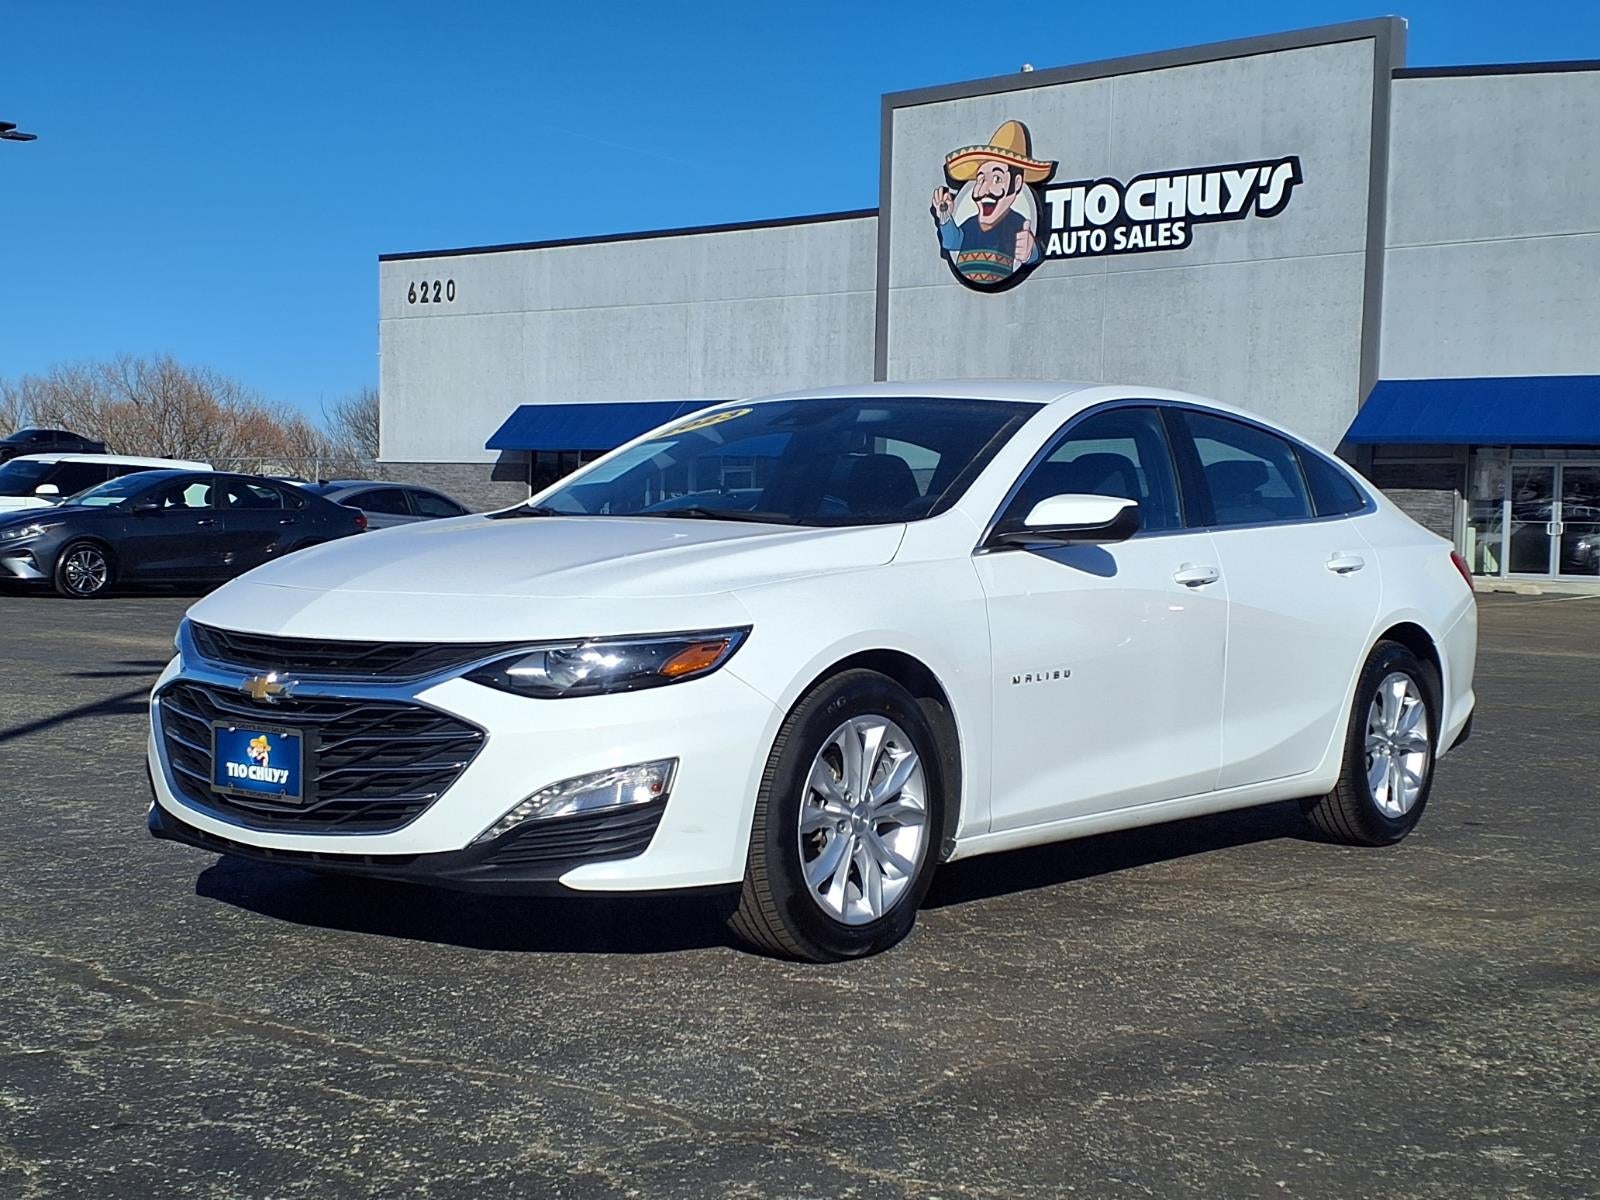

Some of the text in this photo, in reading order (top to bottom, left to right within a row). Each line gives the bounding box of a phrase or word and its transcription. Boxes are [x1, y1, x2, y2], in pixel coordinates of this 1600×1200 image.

[1045, 162, 1293, 229] TIO CHUY'S
[1045, 222, 1186, 256] AUTO SALES
[408, 279, 456, 304] 6220
[1012, 669, 1071, 685] MALIBU
[226, 762, 289, 784] TIO CHUY'S
